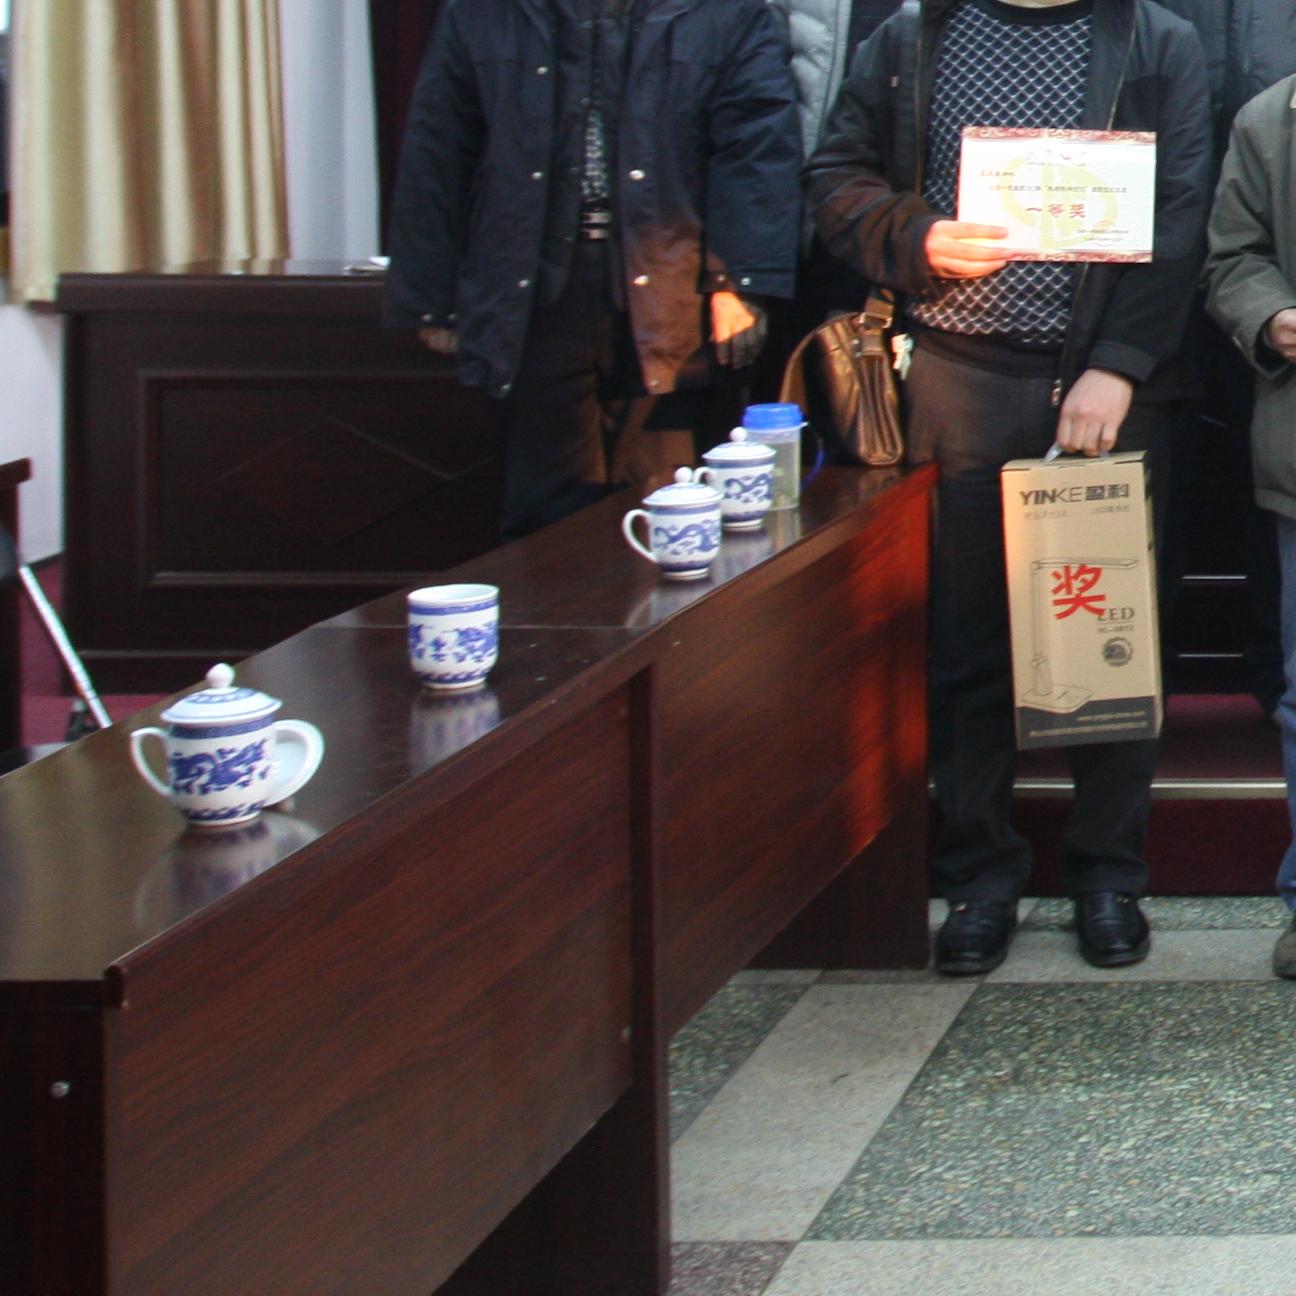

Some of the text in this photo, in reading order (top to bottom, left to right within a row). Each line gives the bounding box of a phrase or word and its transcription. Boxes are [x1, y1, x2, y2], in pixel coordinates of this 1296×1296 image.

[1026, 203, 1086, 218] 一等奖
[1019, 487, 1083, 505] YINKE
[1050, 564, 1106, 621] 奖
